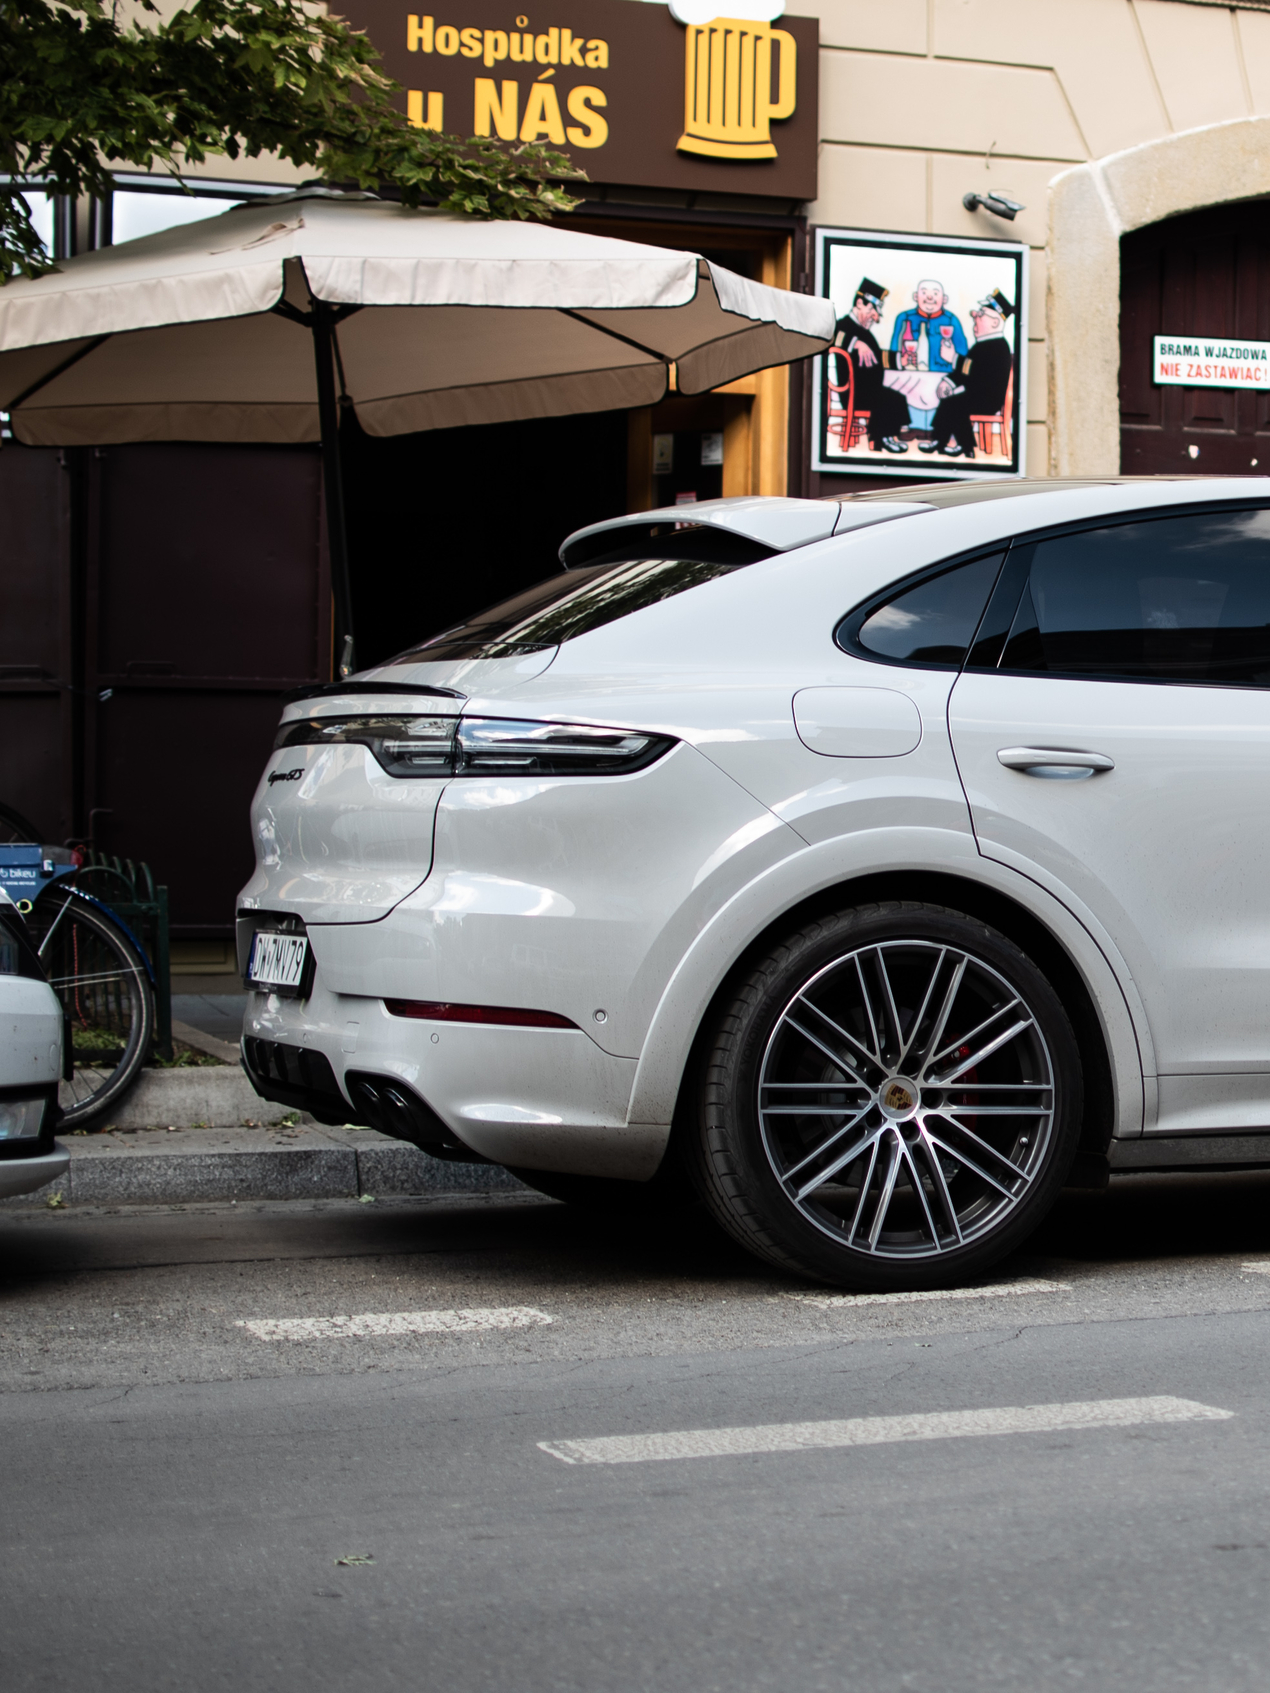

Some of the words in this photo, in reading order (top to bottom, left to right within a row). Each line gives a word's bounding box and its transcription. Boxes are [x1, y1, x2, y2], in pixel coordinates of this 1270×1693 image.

[407, 14, 609, 69] Hospůdka
[407, 90, 444, 132] u
[474, 68, 609, 149] NÁS
[1160, 343, 1200, 357] BRAMA
[1204, 346, 1267, 361] WJAZDOWA
[1160, 362, 1181, 377] NIE
